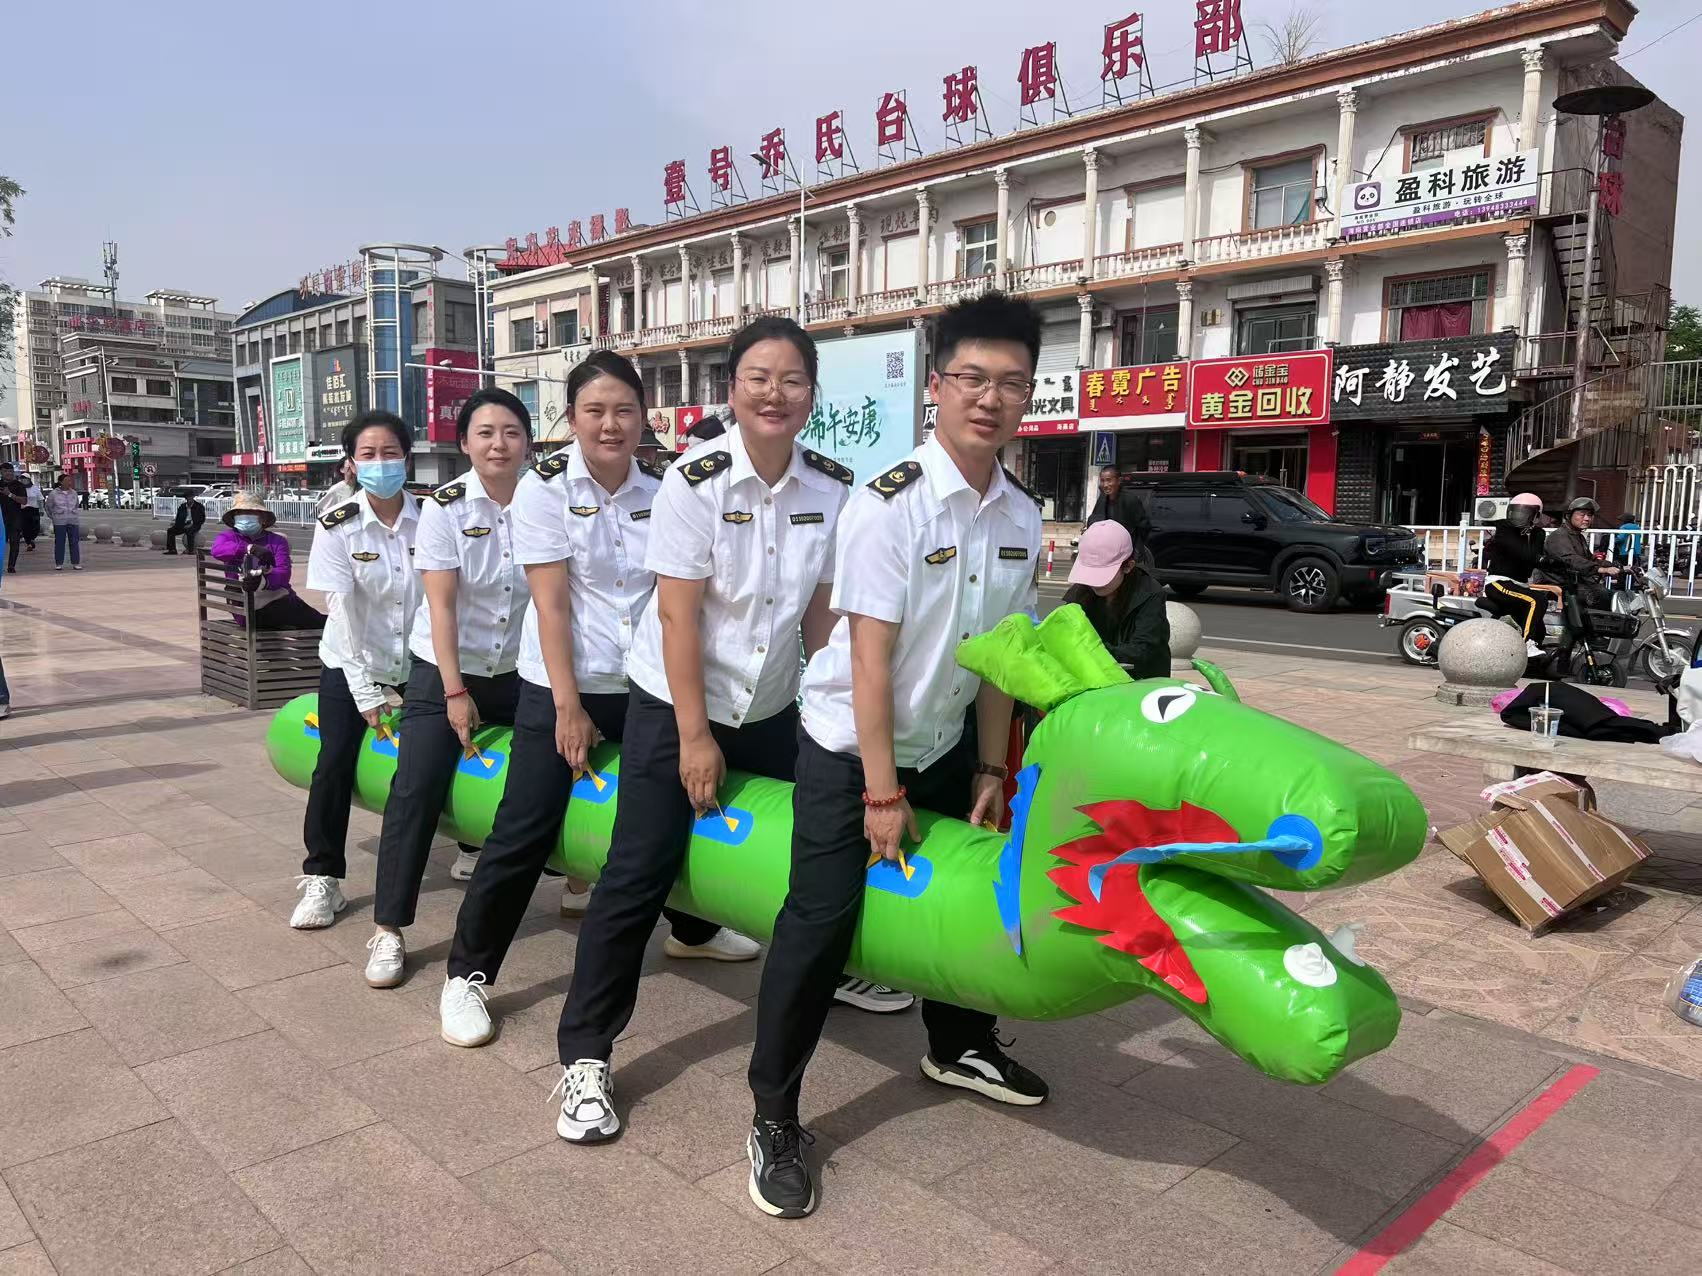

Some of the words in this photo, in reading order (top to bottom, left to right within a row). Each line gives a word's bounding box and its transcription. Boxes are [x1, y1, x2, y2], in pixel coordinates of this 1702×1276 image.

[663, 0, 1242, 203] 壹号乔氏台球俱乐部
[1395, 155, 1527, 204] 盈科旅游
[1086, 365, 1183, 398] 春霓广告
[1201, 386, 1313, 419] 黄金回收
[1334, 346, 1507, 407] 阿静发艺
[800, 395, 881, 453] 端午安康
